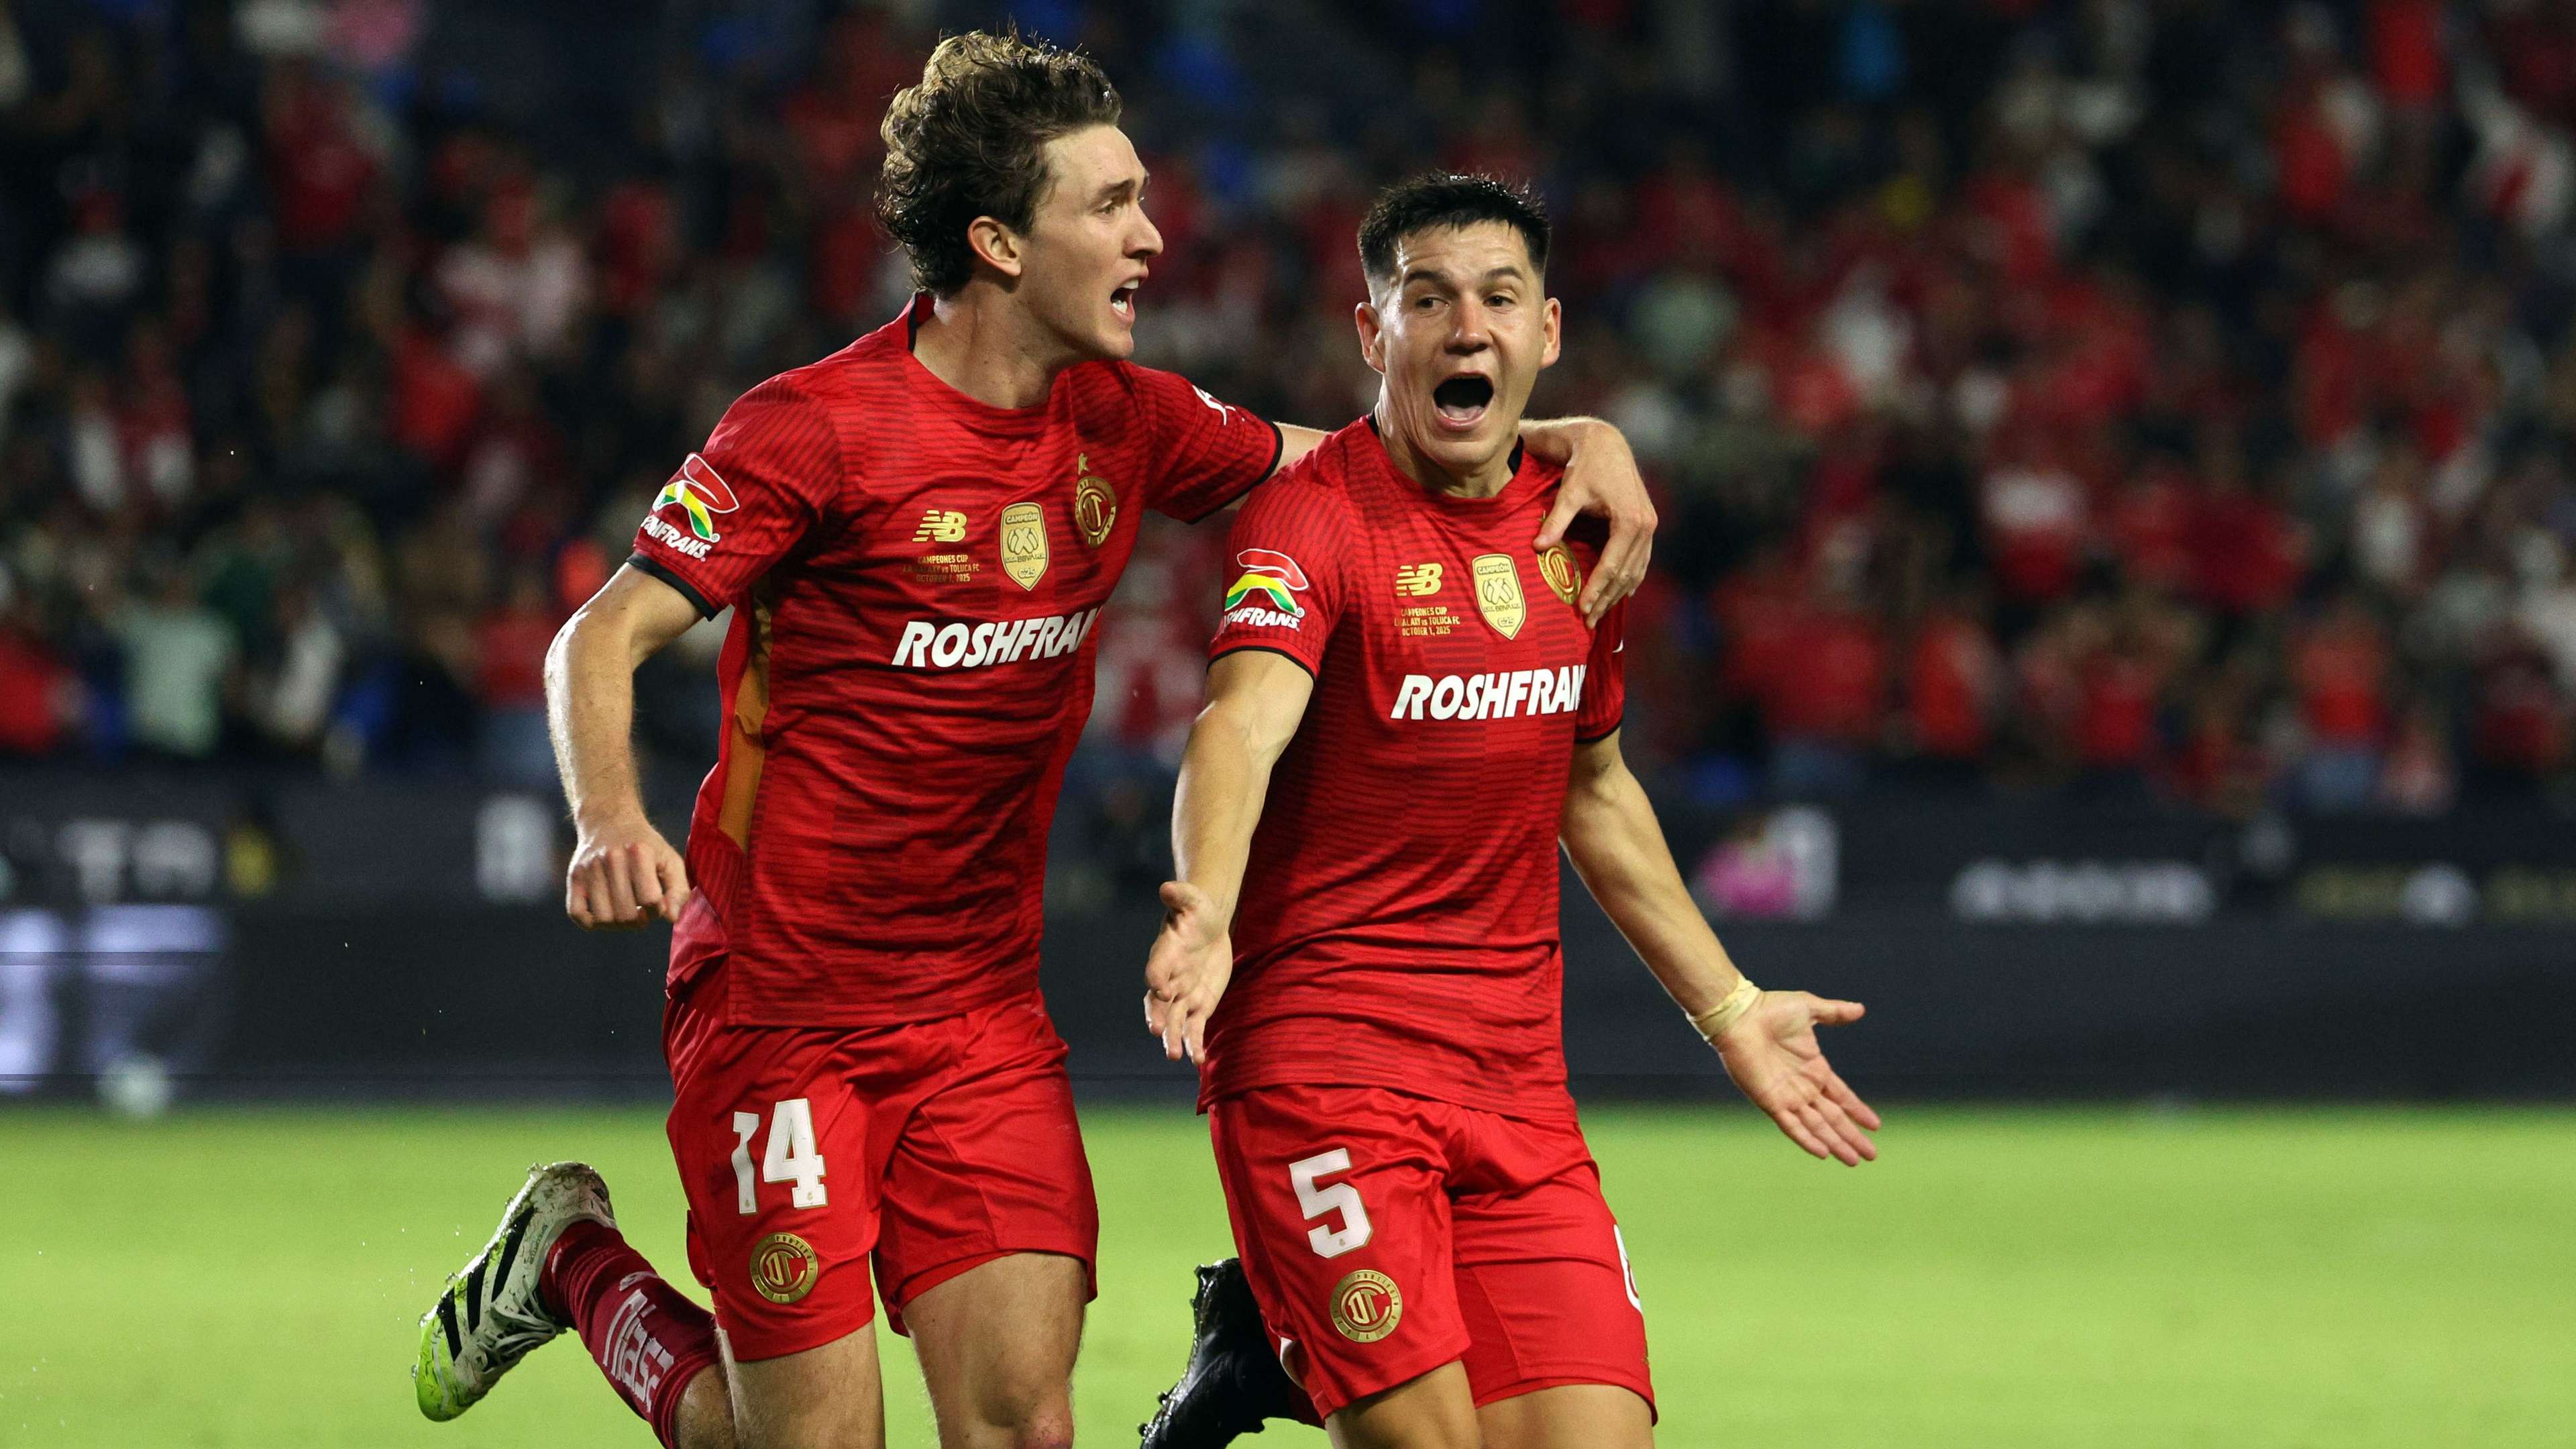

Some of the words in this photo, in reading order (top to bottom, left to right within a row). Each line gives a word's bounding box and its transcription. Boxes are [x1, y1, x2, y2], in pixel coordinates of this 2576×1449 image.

[918, 555, 955, 564] CAMPEONES
[956, 554, 969, 564] CUP
[949, 564, 972, 573] TOLUCA
[973, 564, 979, 572] FC
[956, 573, 971, 582] 2025
[1435, 606, 1448, 615] CUP
[1429, 616, 1452, 625] TOLUCA
[1452, 616, 1460, 625] FC
[1436, 626, 1450, 635] 2025
[731, 1097, 828, 1215] 14
[1289, 1148, 1373, 1258] 5
